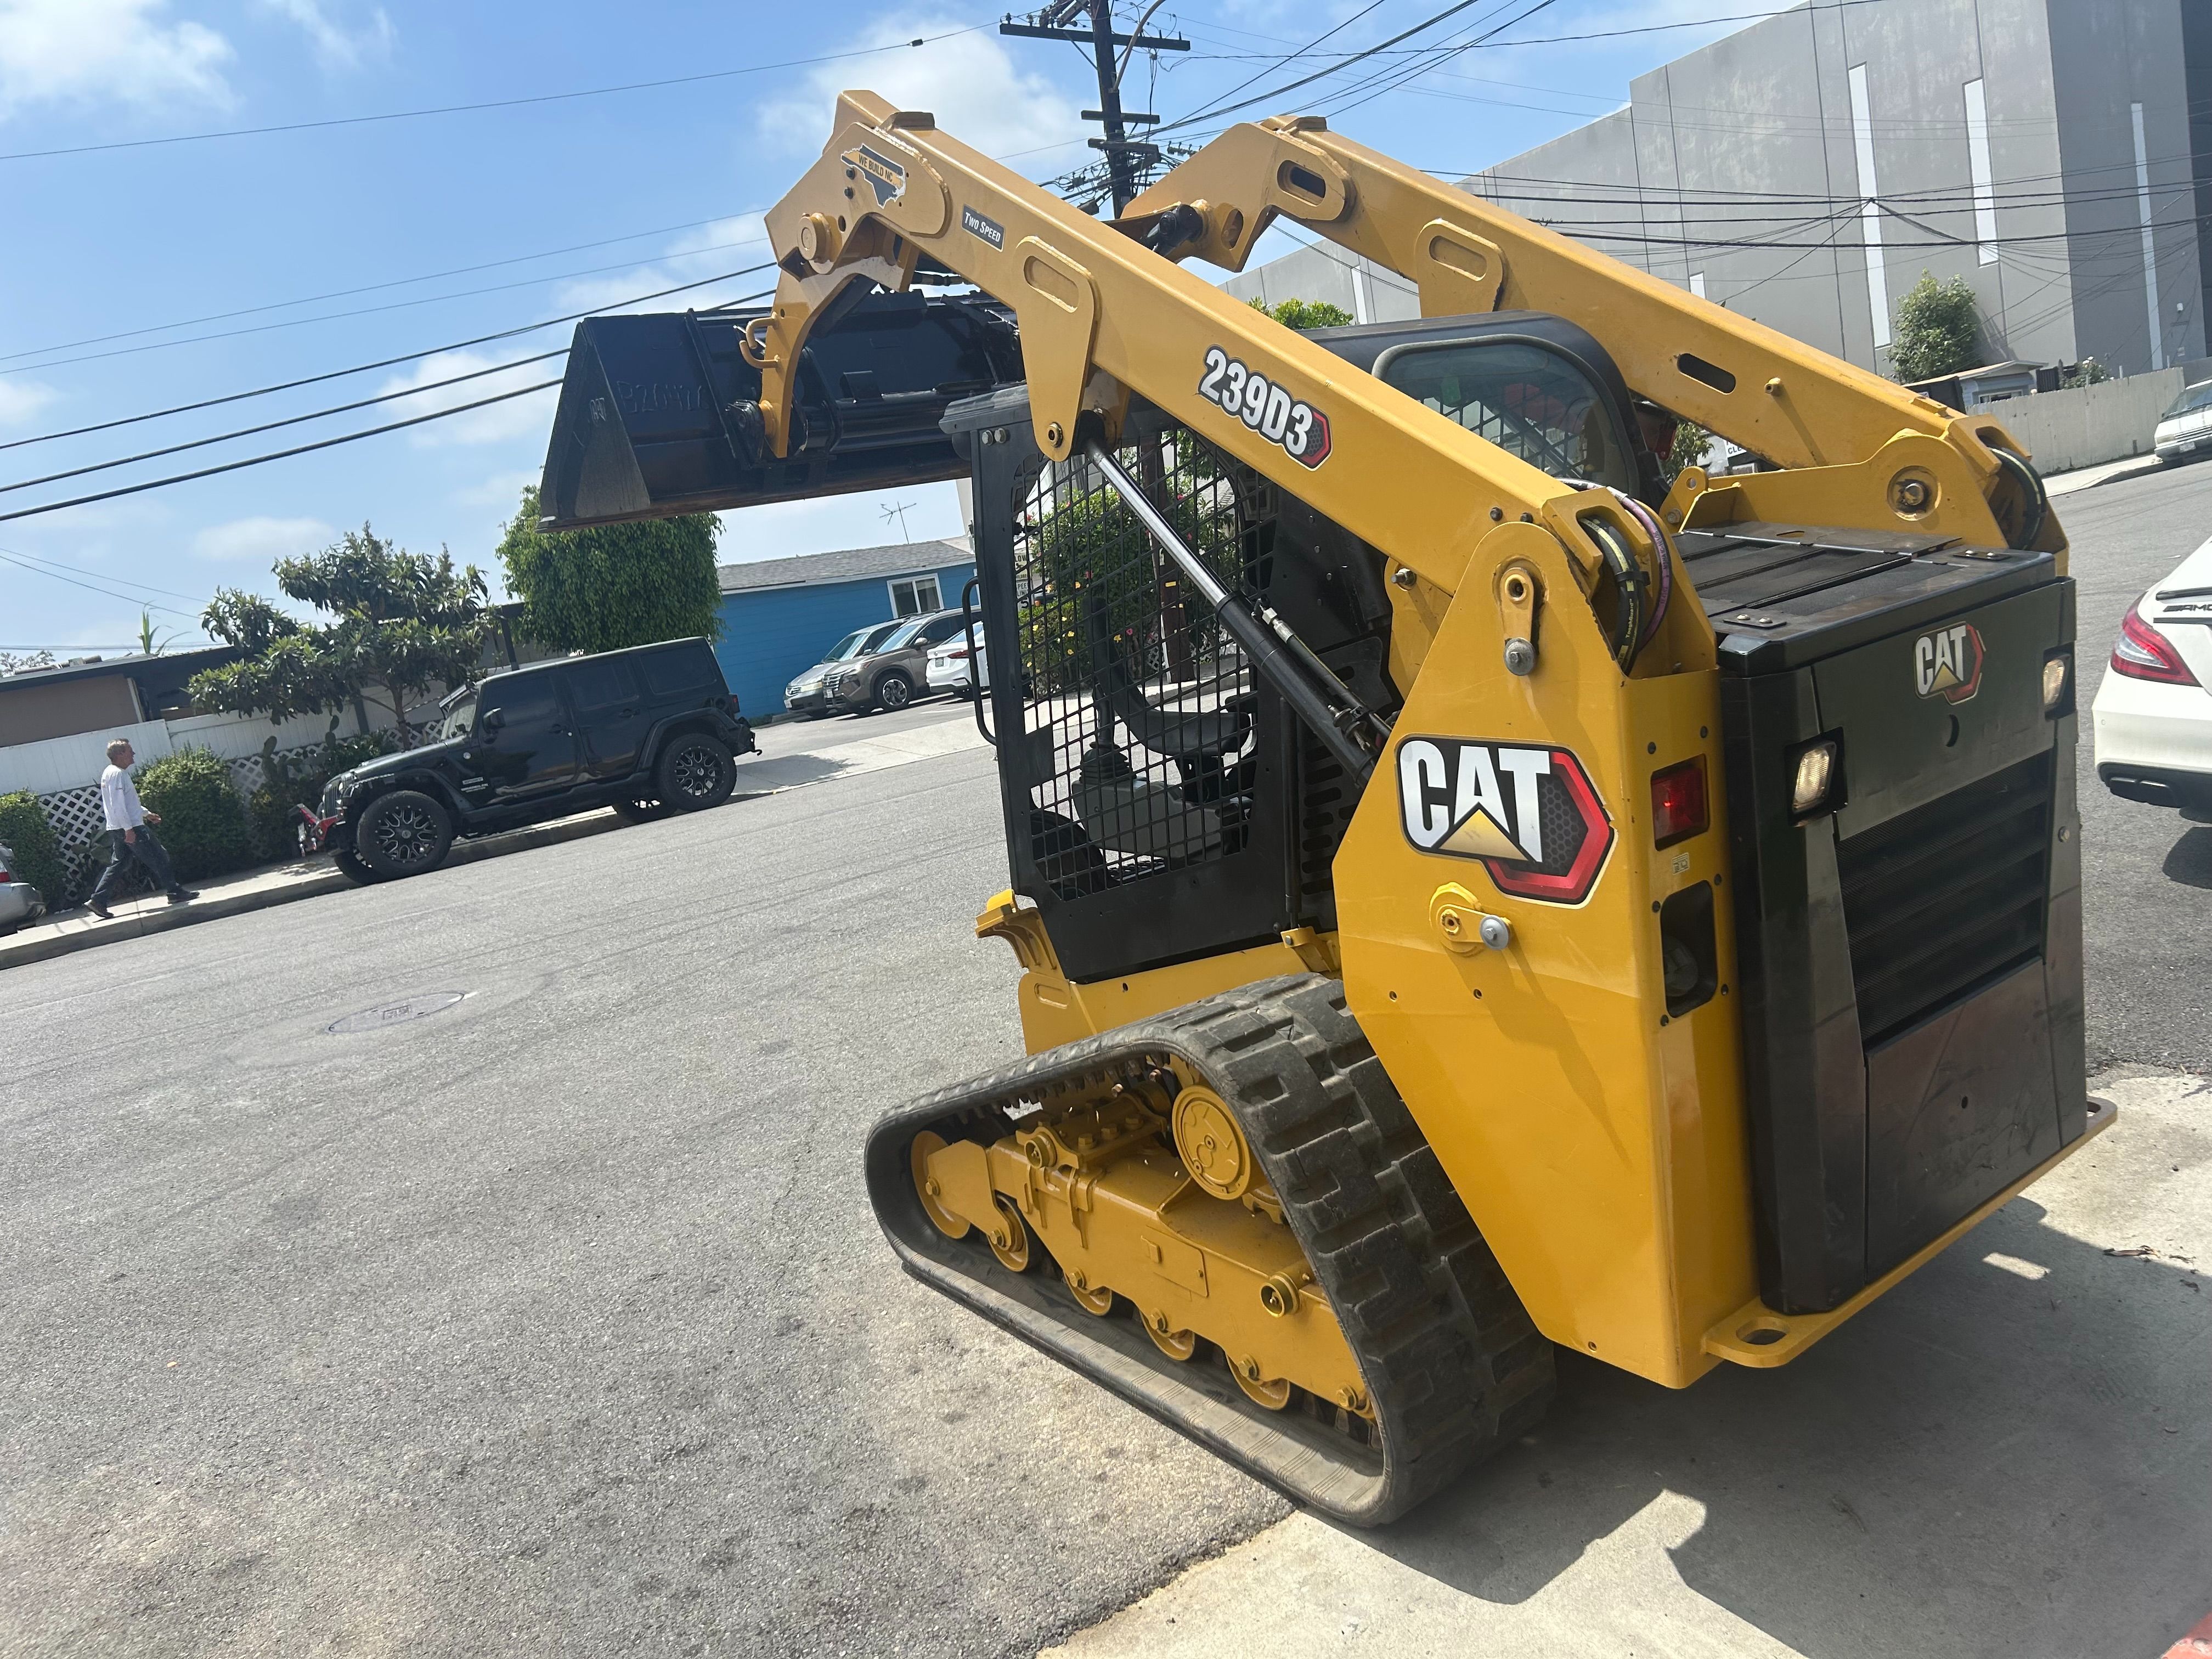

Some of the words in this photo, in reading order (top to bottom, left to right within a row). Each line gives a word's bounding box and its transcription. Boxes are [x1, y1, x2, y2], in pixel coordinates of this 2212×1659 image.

[859, 154, 867, 166] WE
[868, 160, 884, 177] BUILD
[885, 169, 893, 182] NC
[964, 212, 979, 230] TWO
[979, 221, 1001, 242] SPEED
[1200, 349, 1312, 455] 239D3
[1915, 625, 1967, 695] CAT
[1400, 740, 1550, 863] CAT
